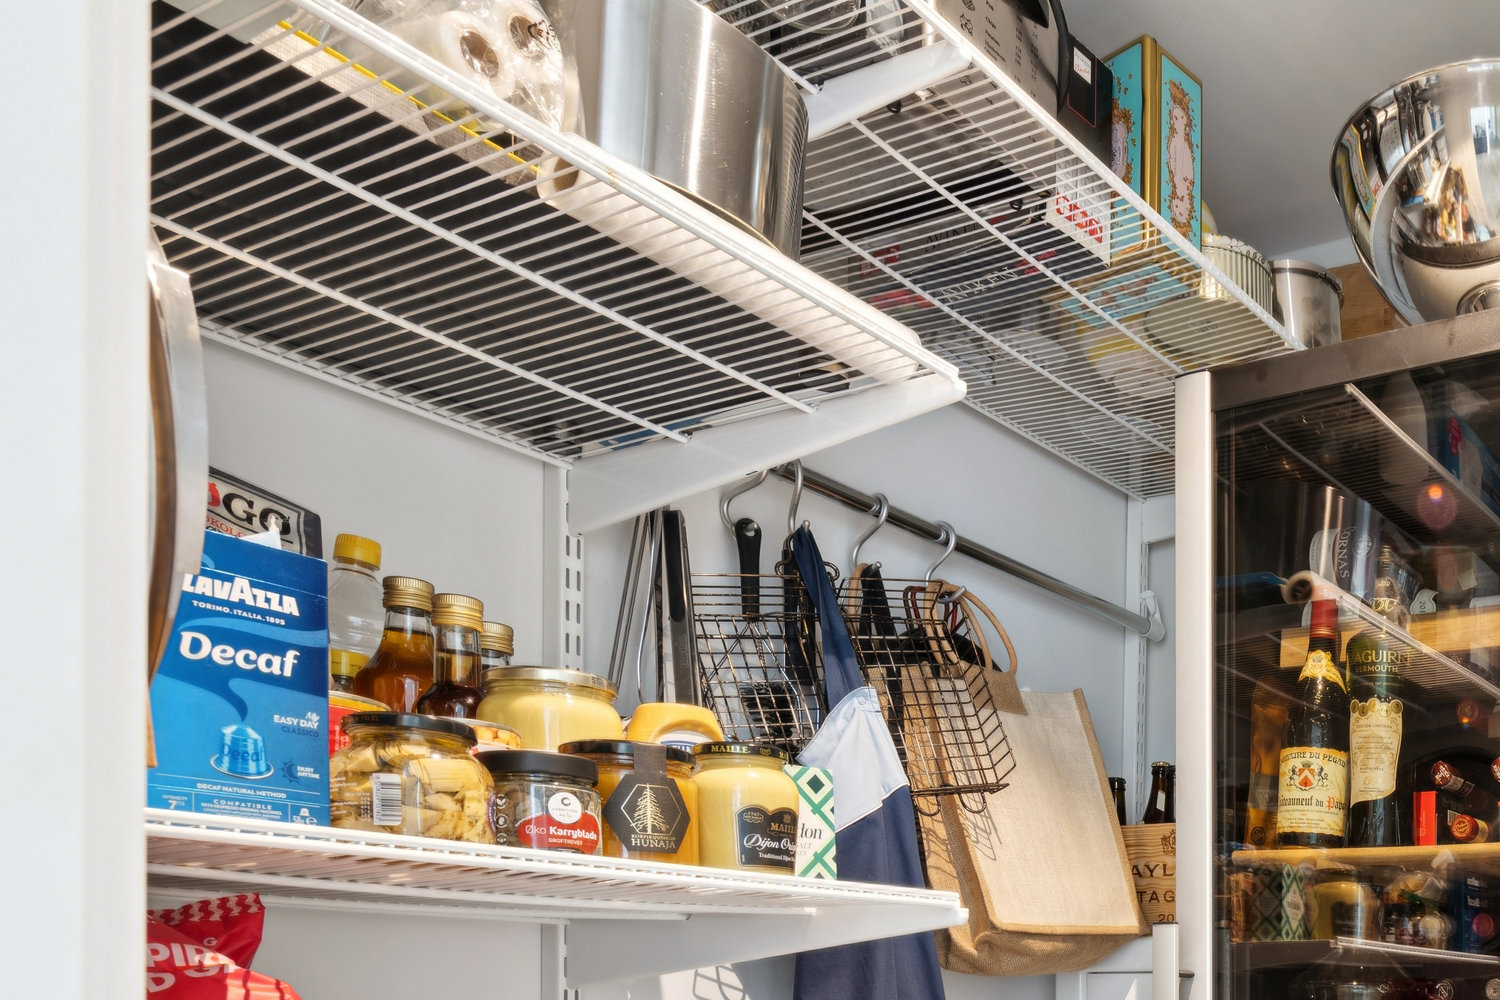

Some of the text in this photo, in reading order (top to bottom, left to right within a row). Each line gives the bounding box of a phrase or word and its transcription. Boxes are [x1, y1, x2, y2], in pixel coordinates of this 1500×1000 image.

[181, 573, 300, 616] LAVAZZA
[265, 616, 285, 625] 1895
[179, 631, 300, 678] Decaf
[273, 714, 319, 729] EASY DAY
[281, 726, 319, 737] CLASSICO
[711, 745, 749, 753] MAILLE
[197, 783, 287, 799] DECAF NATURAL METHOD
[213, 799, 272, 810] COMPATIBLE
[525, 825, 597, 841] Øko Karryblade
[770, 822, 796, 833] MAILL
[631, 838, 676, 849] HUNAJA
[744, 833, 796, 854] Dijon Orig
